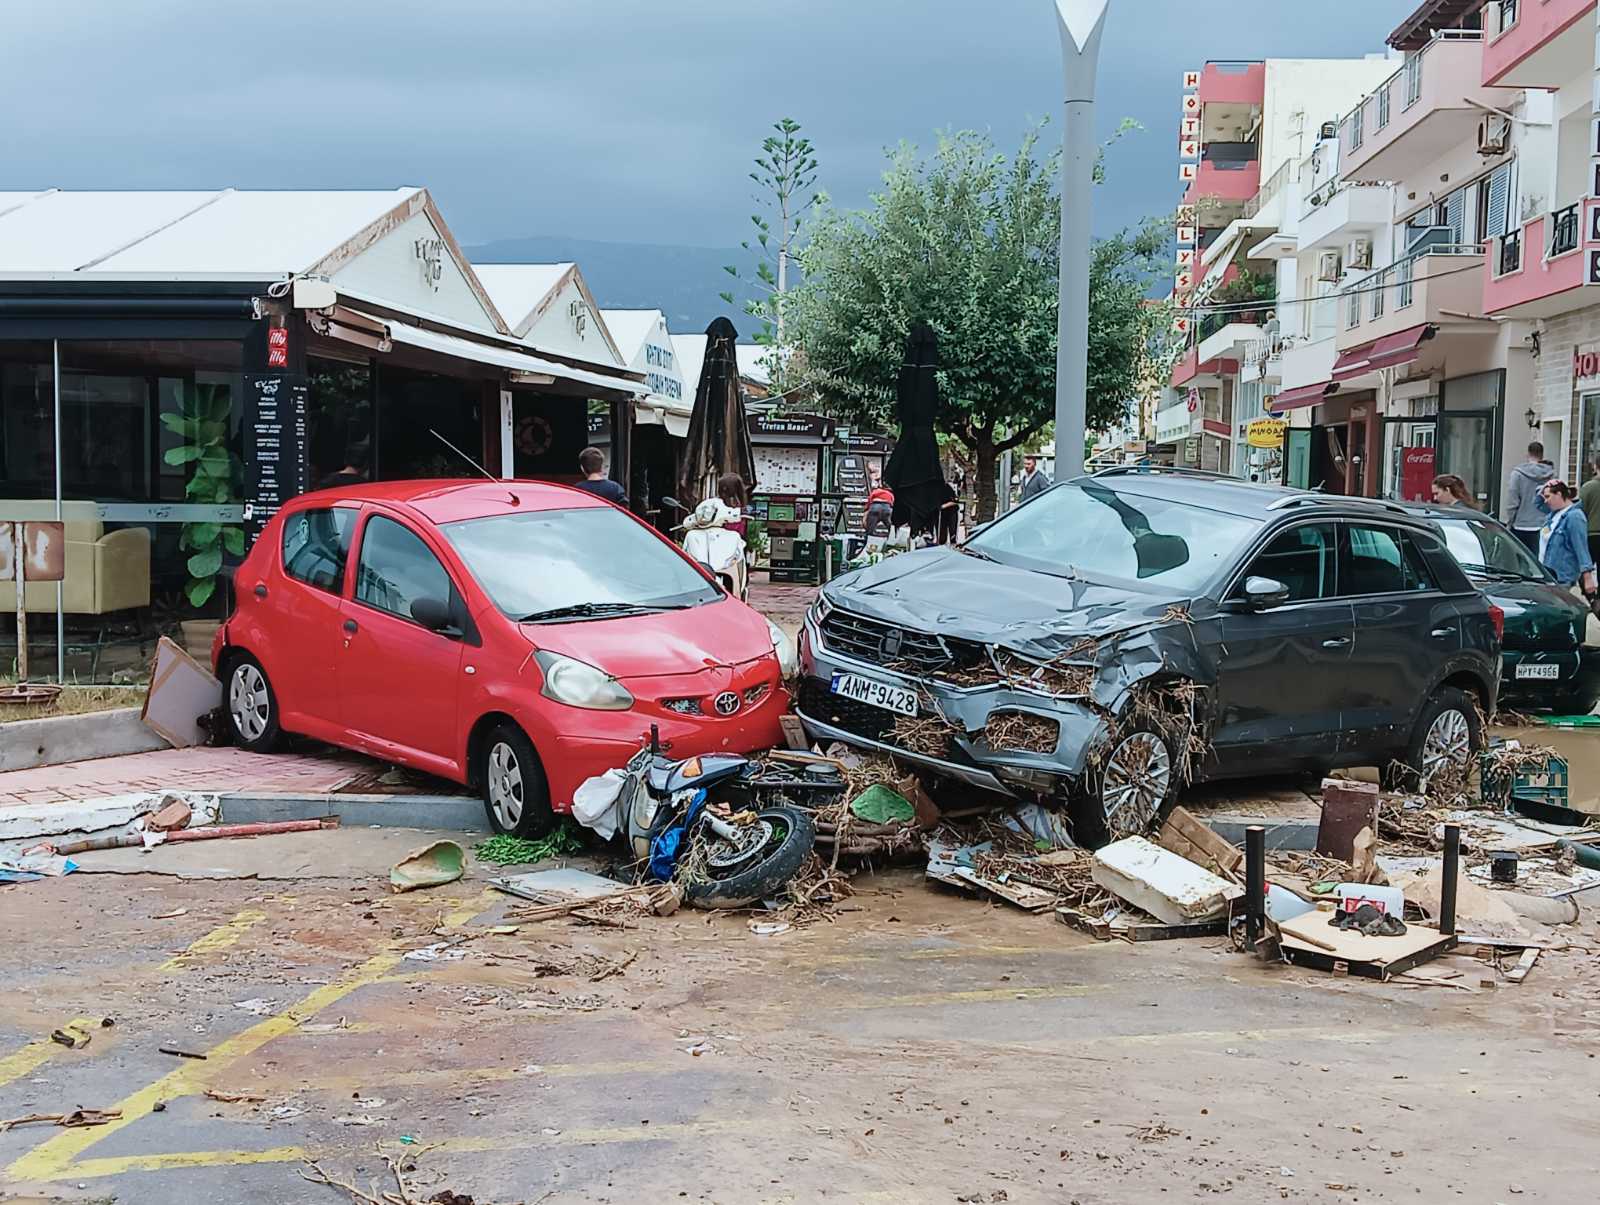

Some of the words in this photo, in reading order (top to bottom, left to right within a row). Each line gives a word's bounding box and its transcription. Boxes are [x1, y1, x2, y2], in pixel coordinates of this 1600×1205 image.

[1184, 74, 1197, 178] HOTEL
[269, 332, 286, 345] illy
[269, 350, 286, 364] illy
